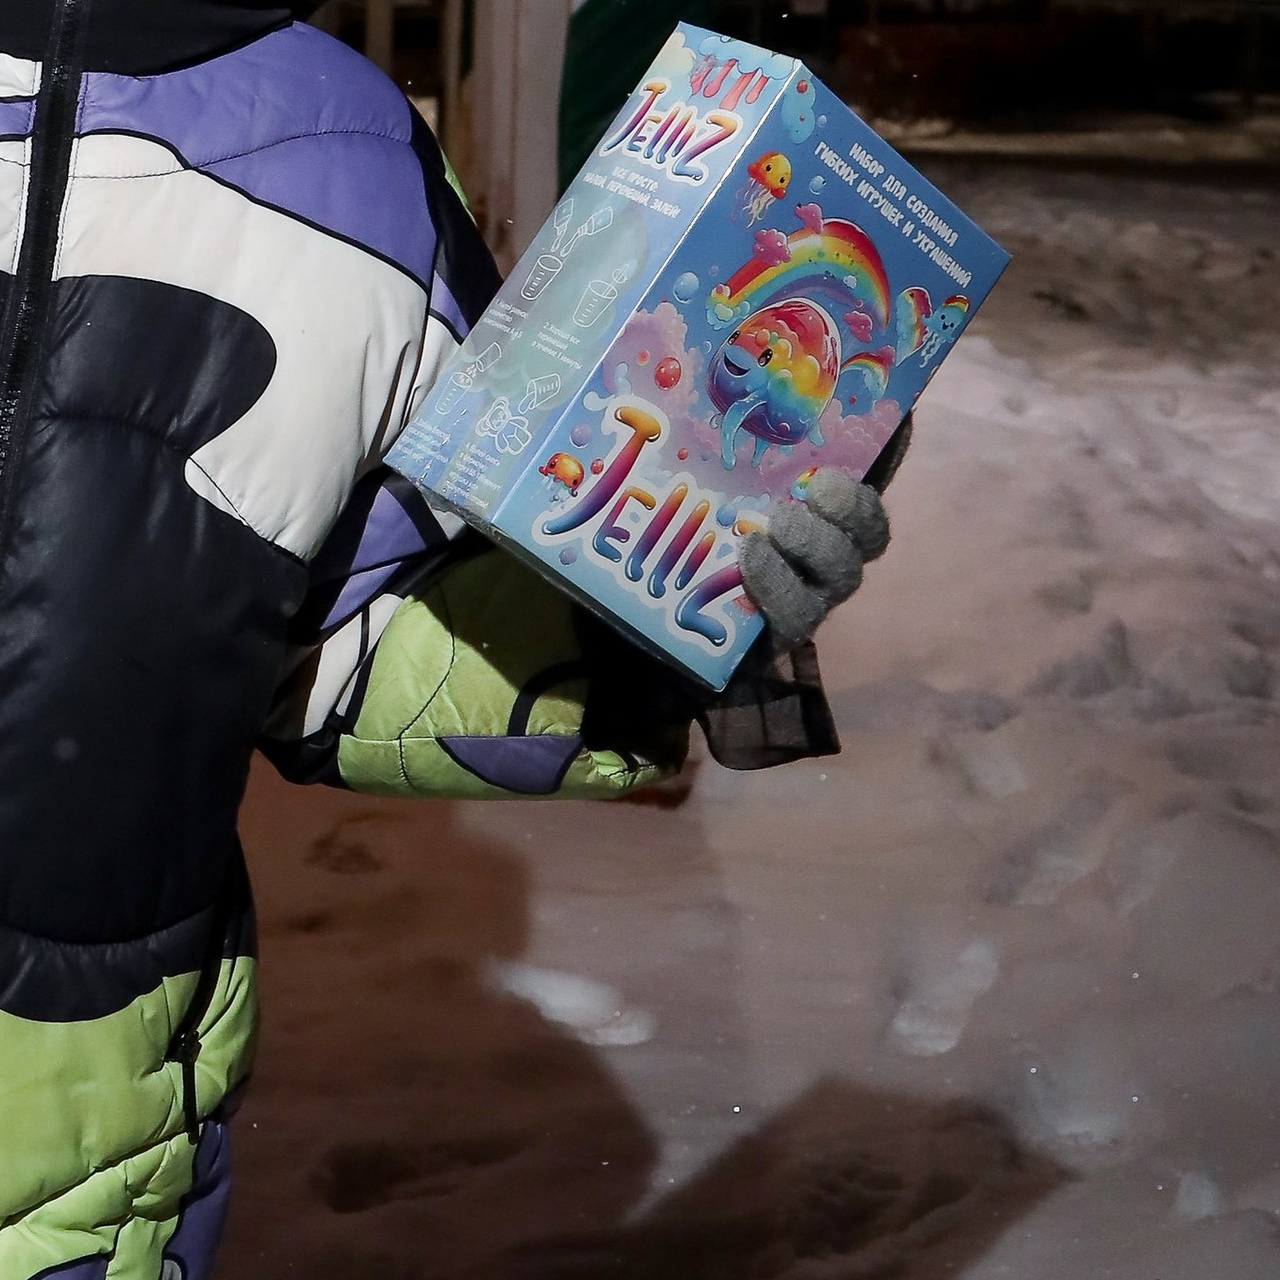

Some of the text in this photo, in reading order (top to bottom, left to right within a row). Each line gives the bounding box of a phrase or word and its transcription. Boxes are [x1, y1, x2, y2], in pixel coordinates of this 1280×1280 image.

[814, 141, 972, 288] ГИБКИХ ИГРУШЕК И УКРАШЕНИЙ
[848, 142, 959, 247] НАБОР ДЛЯ СОЗДАНИЯ
